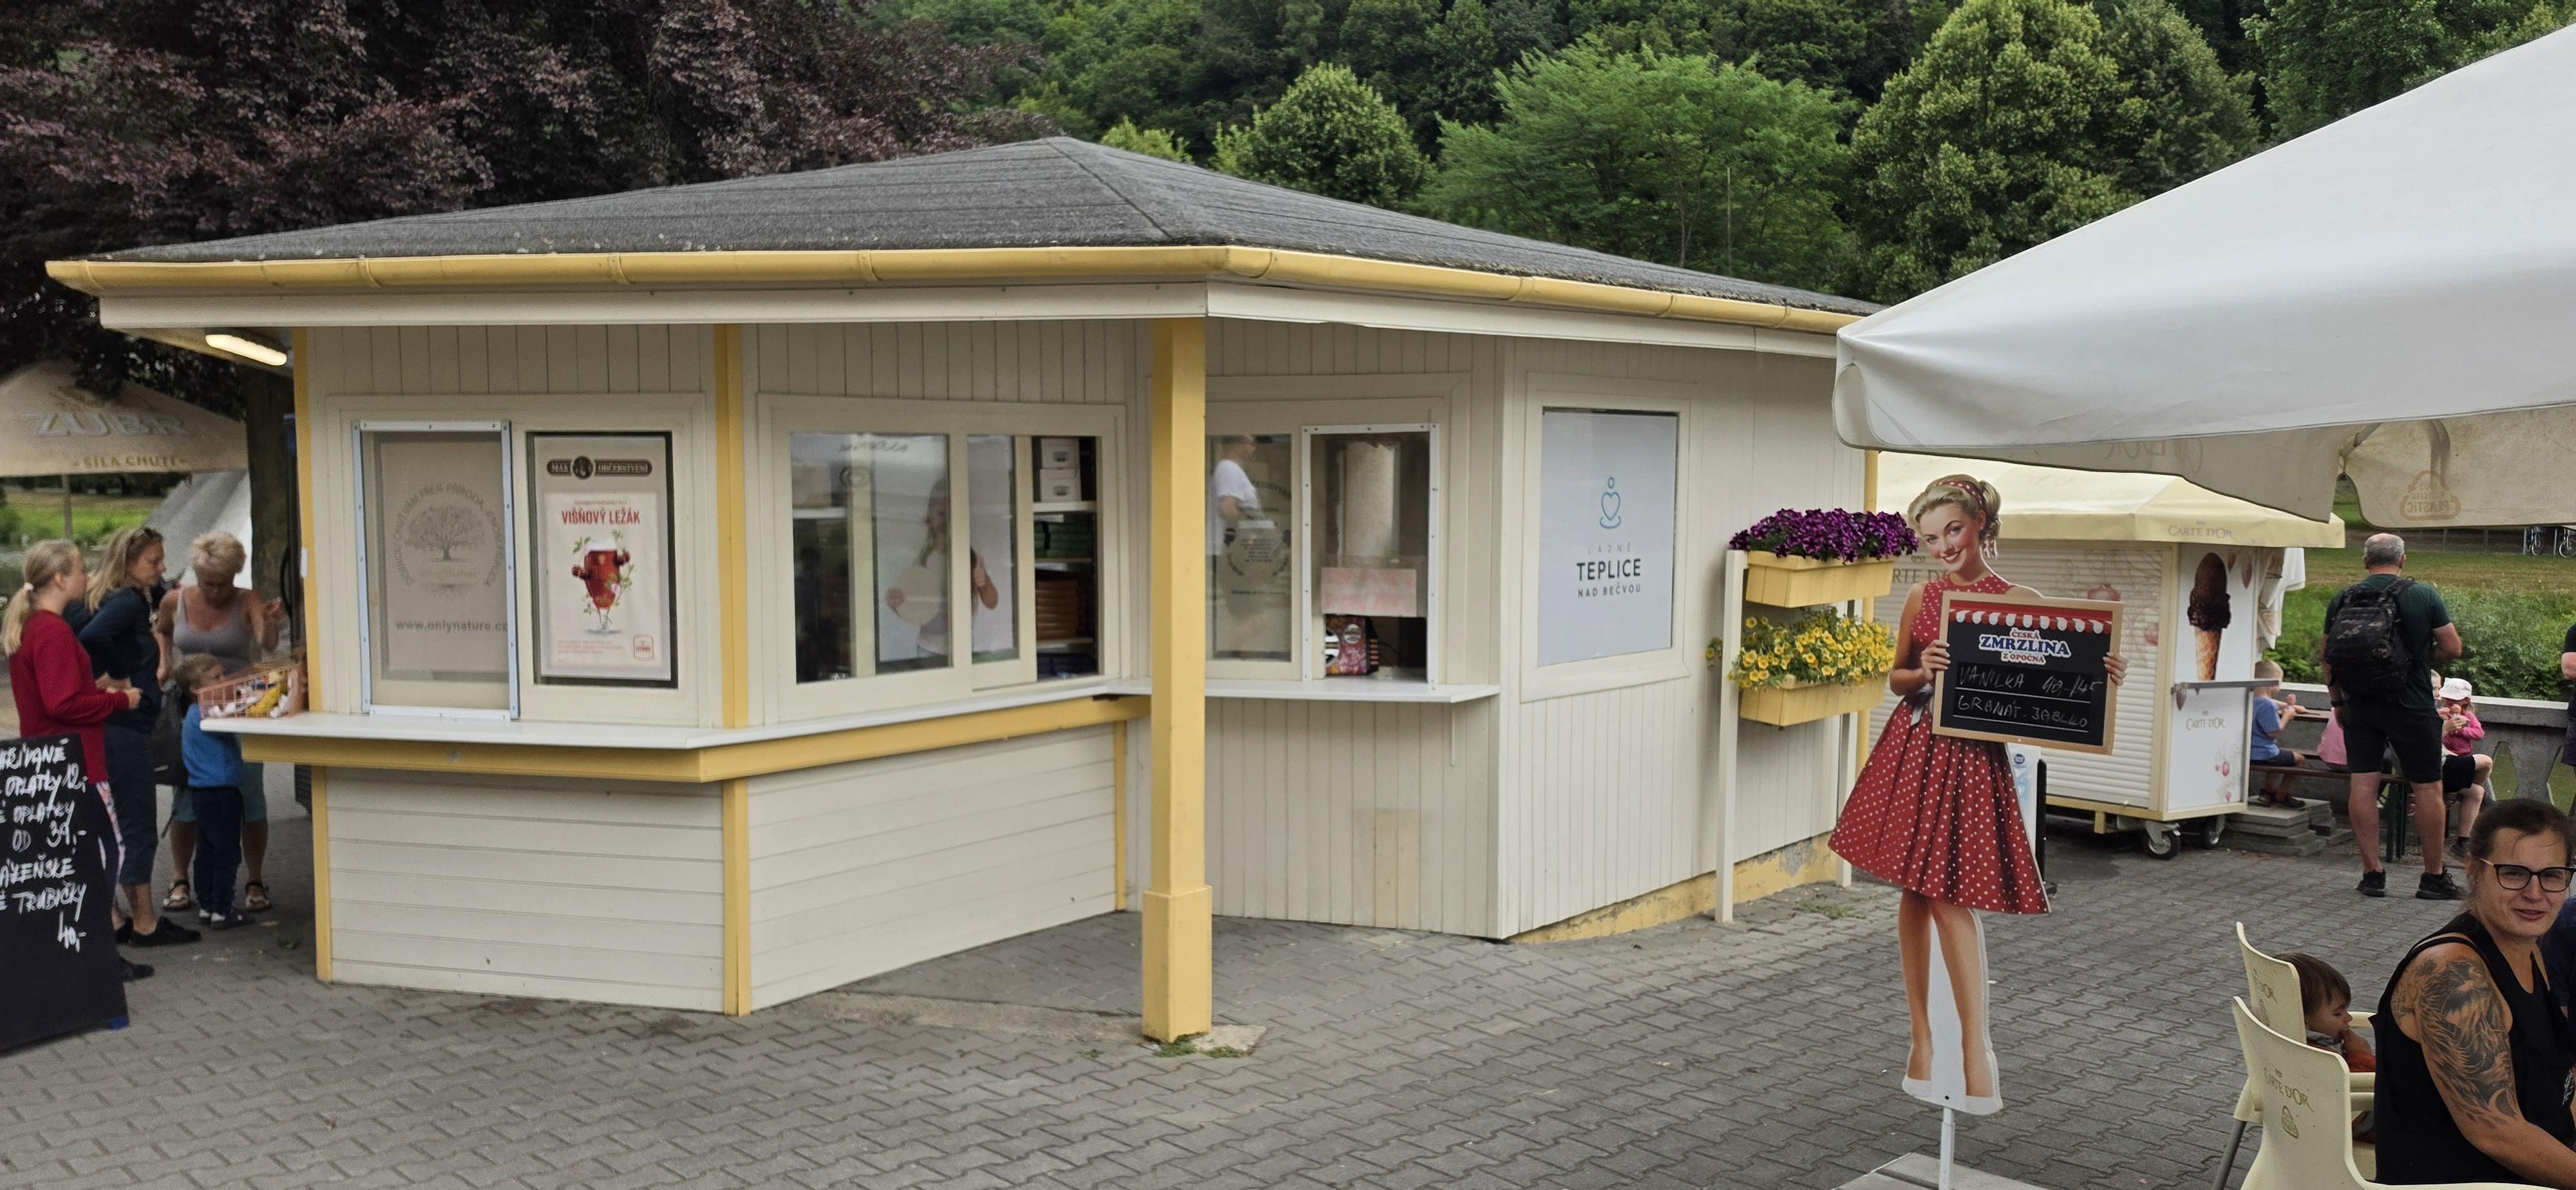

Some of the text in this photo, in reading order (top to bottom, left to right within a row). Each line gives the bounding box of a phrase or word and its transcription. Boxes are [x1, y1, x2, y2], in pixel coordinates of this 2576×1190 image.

[562, 507, 640, 525] VIŠŇOVÝ LEŽÁK
[2168, 525, 2202, 536] CARTE
[1588, 542, 1631, 554] LÁZNĚ
[1576, 558, 1641, 581] TEPLICE
[1892, 568, 1922, 583] RTE
[1578, 581, 1641, 598] NAD BEČVOU
[395, 619, 508, 633] www.onlynature.cz
[2011, 628, 2040, 639] ČESKÁ
[1980, 636, 2070, 656] ZMRZLINA
[1960, 666, 2024, 689] VANILKA
[13, 800, 75, 827] OPLATKY
[12, 828, 32, 853] OD
[12, 880, 87, 922] TRUBIČKY
